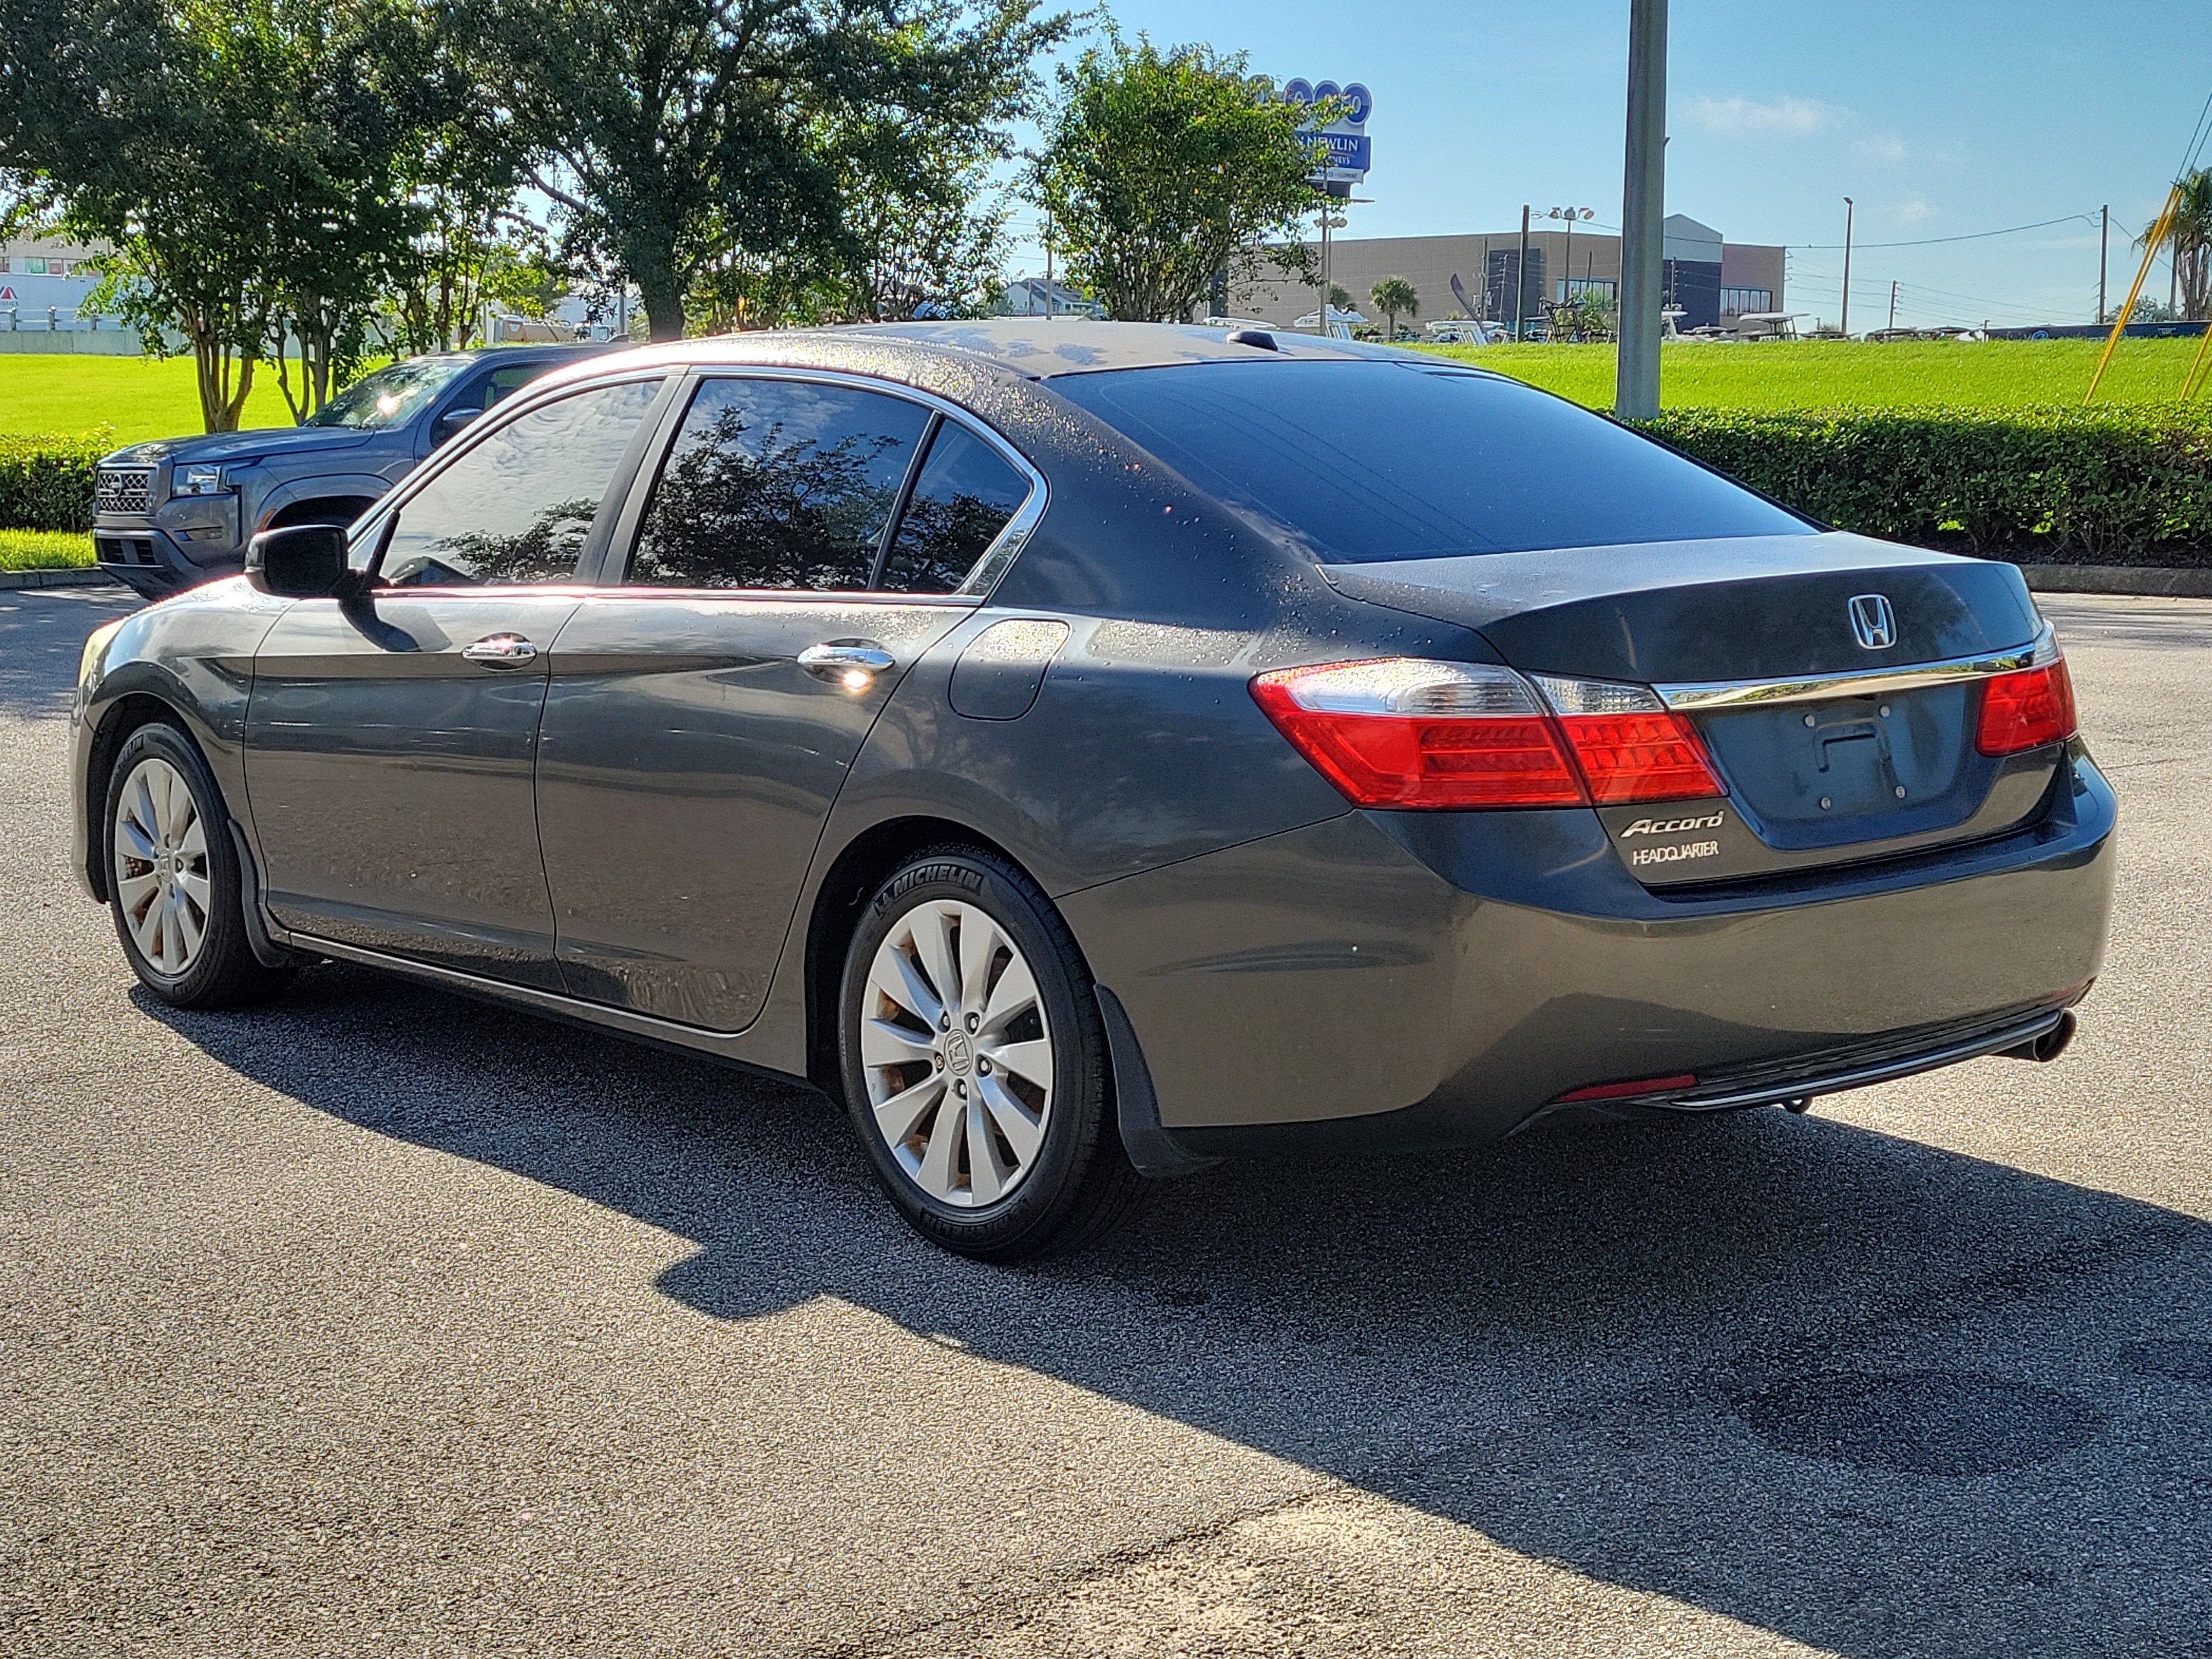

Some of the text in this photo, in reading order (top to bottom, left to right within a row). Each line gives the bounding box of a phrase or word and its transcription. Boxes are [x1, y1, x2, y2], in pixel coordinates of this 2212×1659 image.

[1620, 810, 1725, 838] Accord
[1633, 840, 1719, 866] HEADQUARTER
[893, 865, 981, 898] MICHELIN
